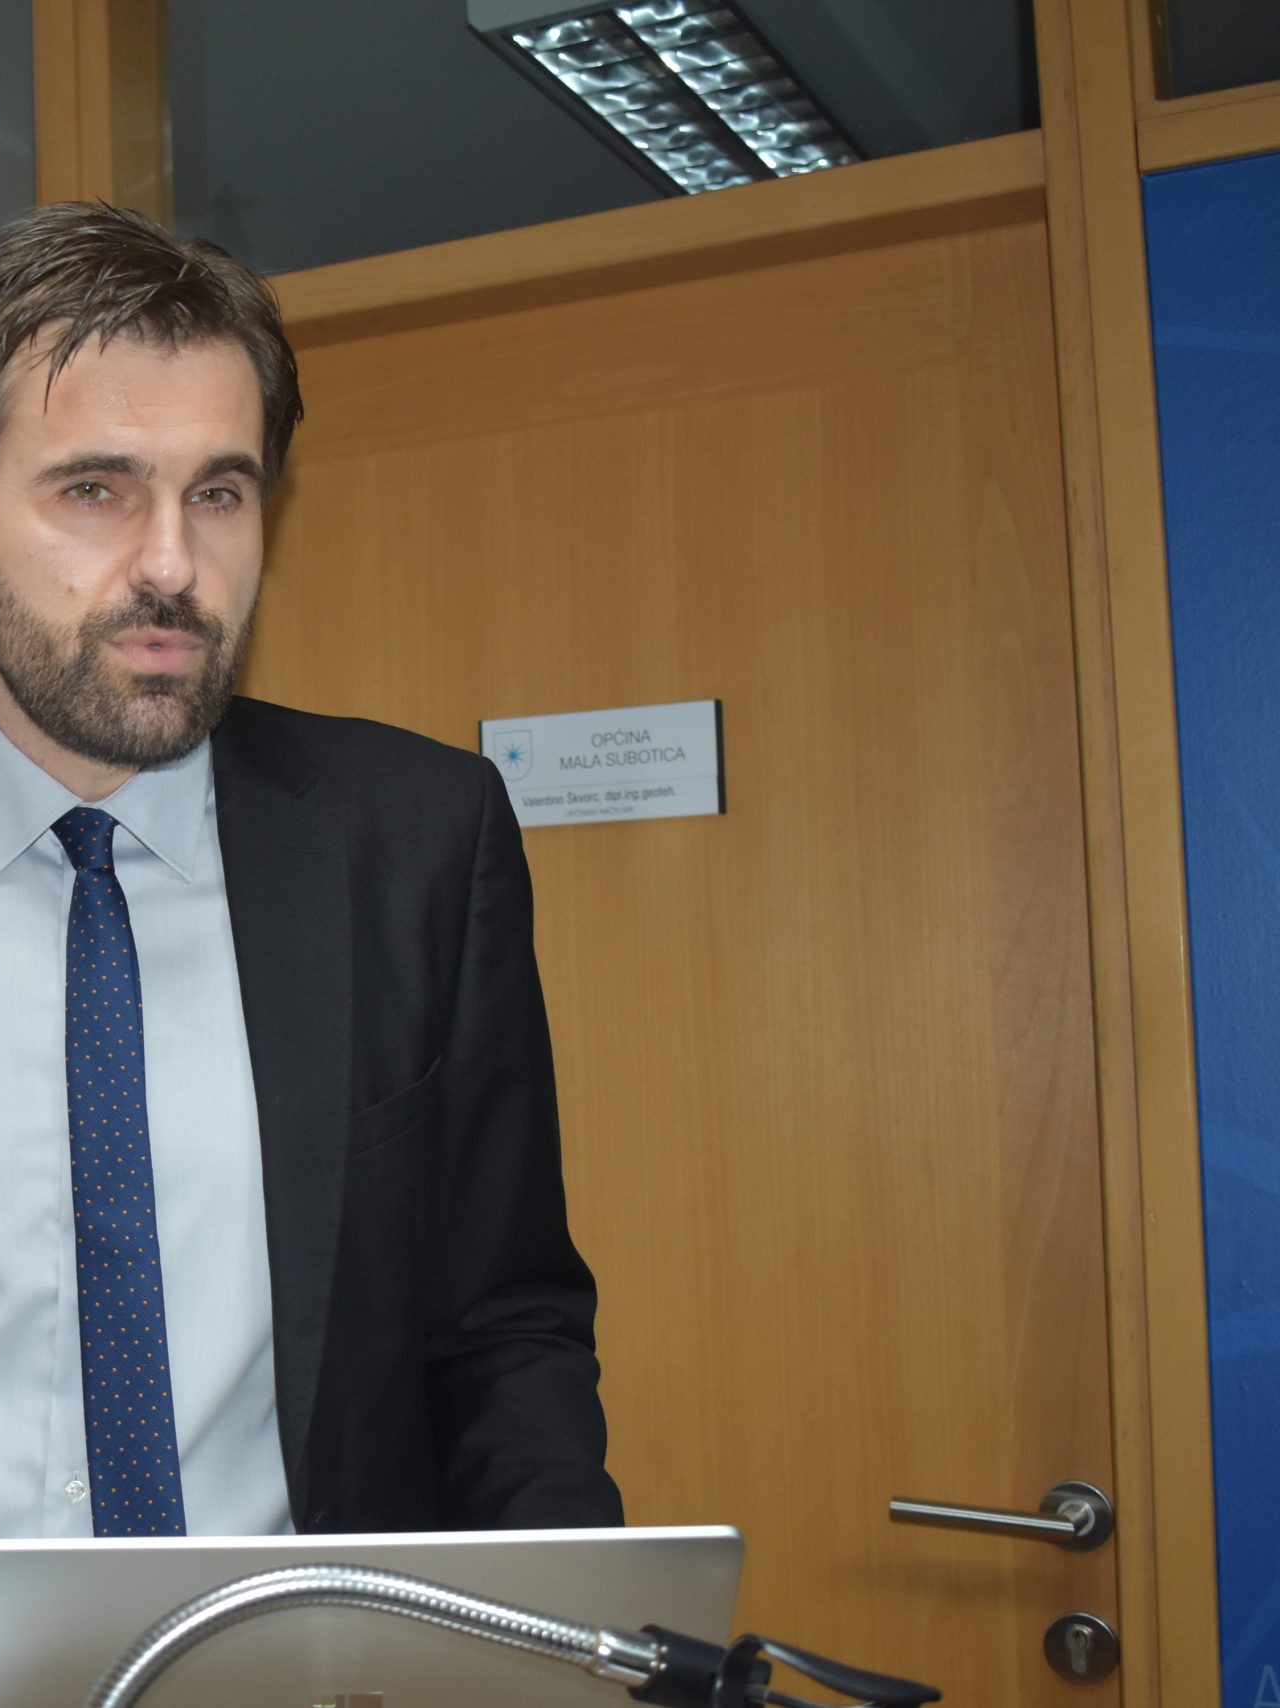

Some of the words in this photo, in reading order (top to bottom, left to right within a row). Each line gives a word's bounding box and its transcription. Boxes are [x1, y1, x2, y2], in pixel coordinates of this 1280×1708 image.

[590, 728, 652, 749] OPĆINA
[559, 754, 602, 771] MALA
[605, 746, 687, 768] SUBOTICA
[522, 794, 565, 808] Valentino
